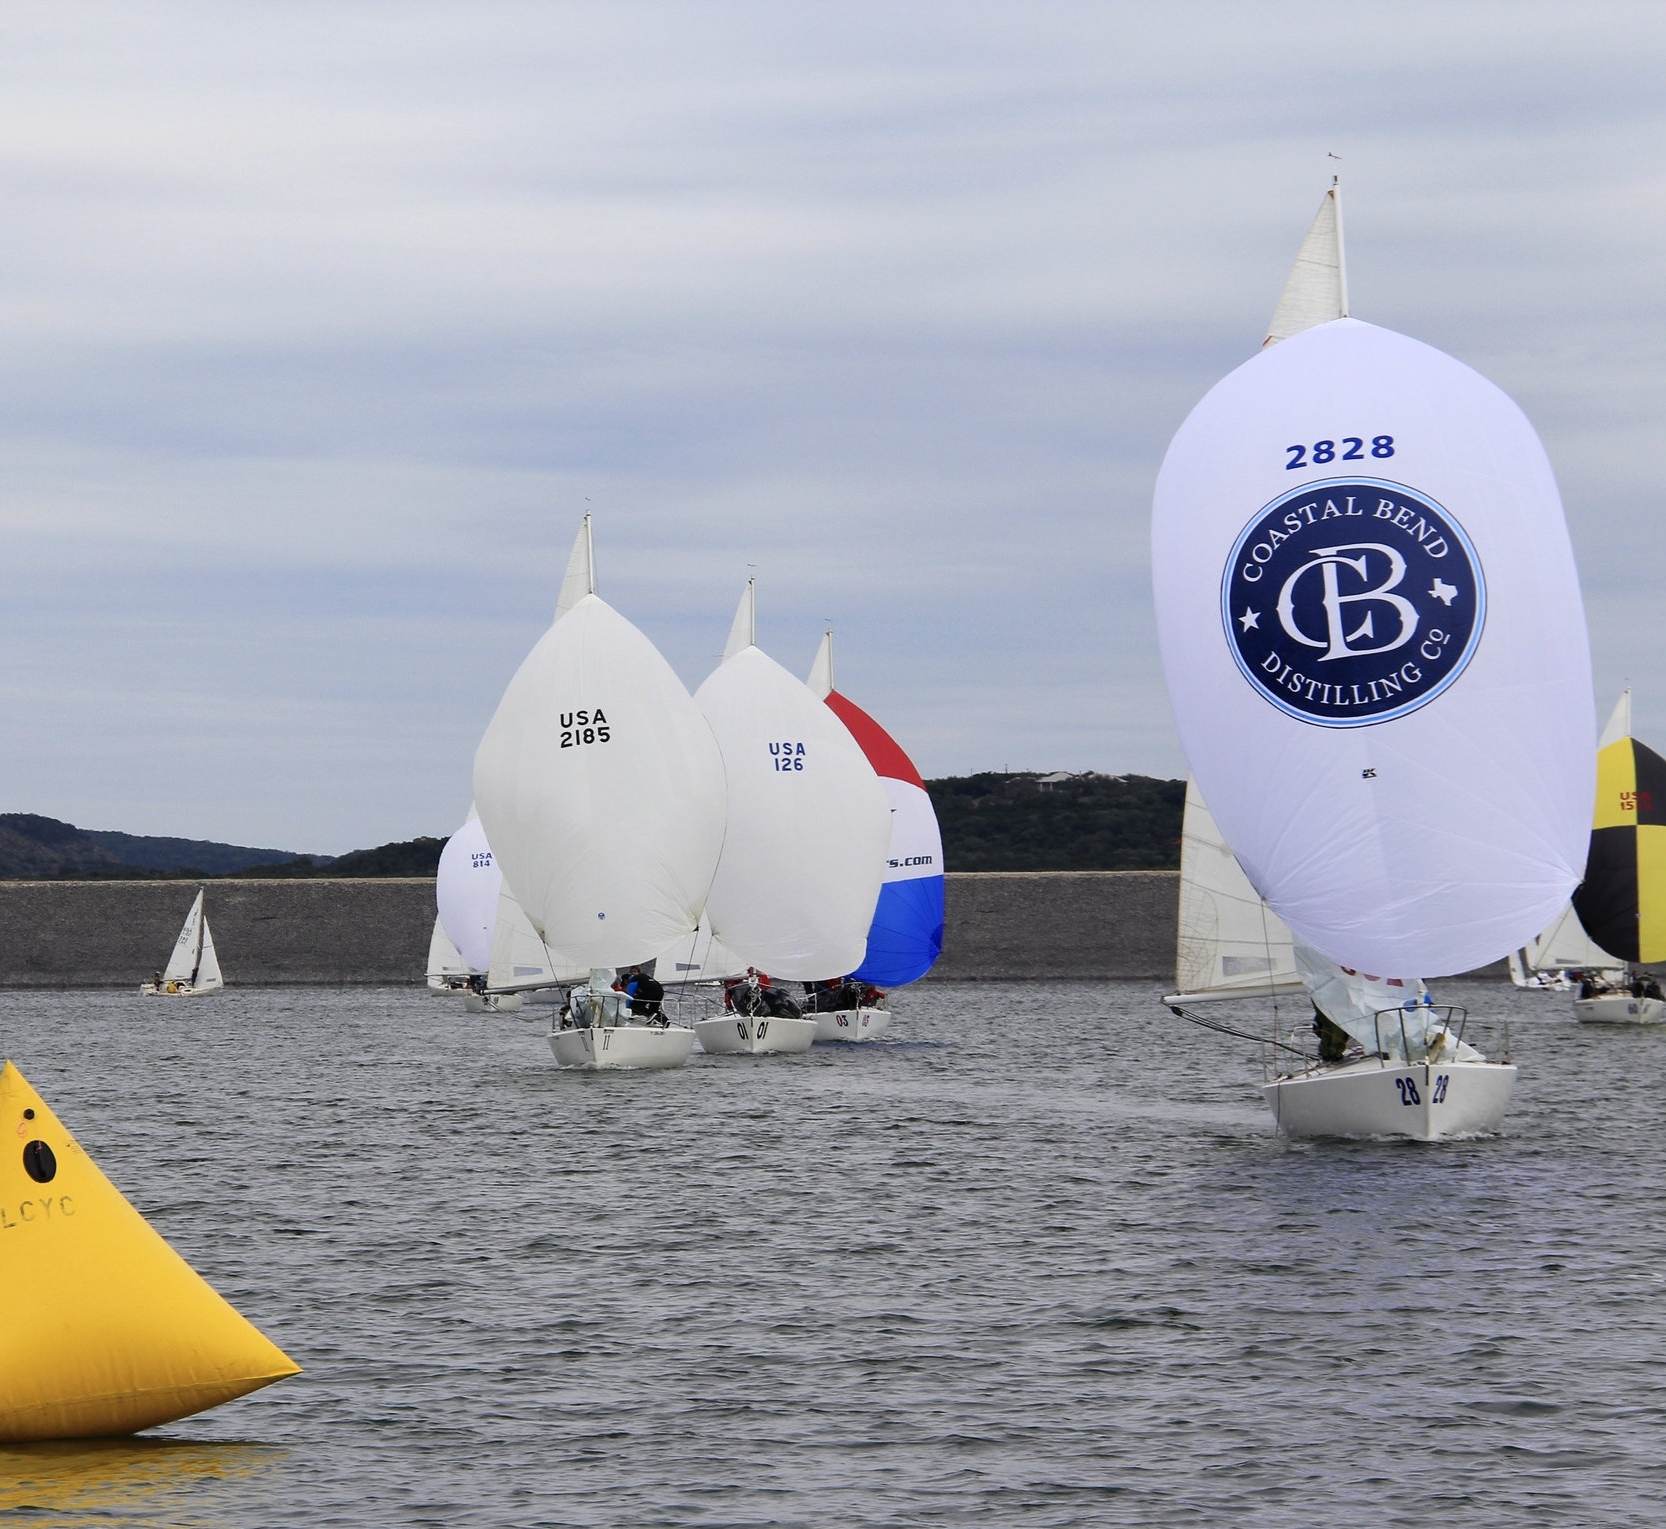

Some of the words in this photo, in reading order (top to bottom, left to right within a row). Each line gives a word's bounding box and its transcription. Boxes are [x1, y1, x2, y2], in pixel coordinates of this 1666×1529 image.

[1286, 435, 1395, 470] 2828
[1243, 497, 1363, 583] COASTAL
[1372, 498, 1449, 559] BEND
[1261, 651, 1422, 706] DISTILLING
[560, 709, 607, 728] USA
[560, 727, 610, 748] 2185
[769, 743, 806, 756] USA
[775, 758, 803, 771] 126
[1620, 792, 1652, 801] USA
[473, 860, 490, 868] 814
[886, 856, 932, 868] s.com
[737, 1022, 749, 1040] 01
[757, 1022, 769, 1040] 01
[1395, 1077, 1421, 1106] 28
[1432, 1075, 1449, 1104] 28
[1, 1195, 75, 1229] LCYC
